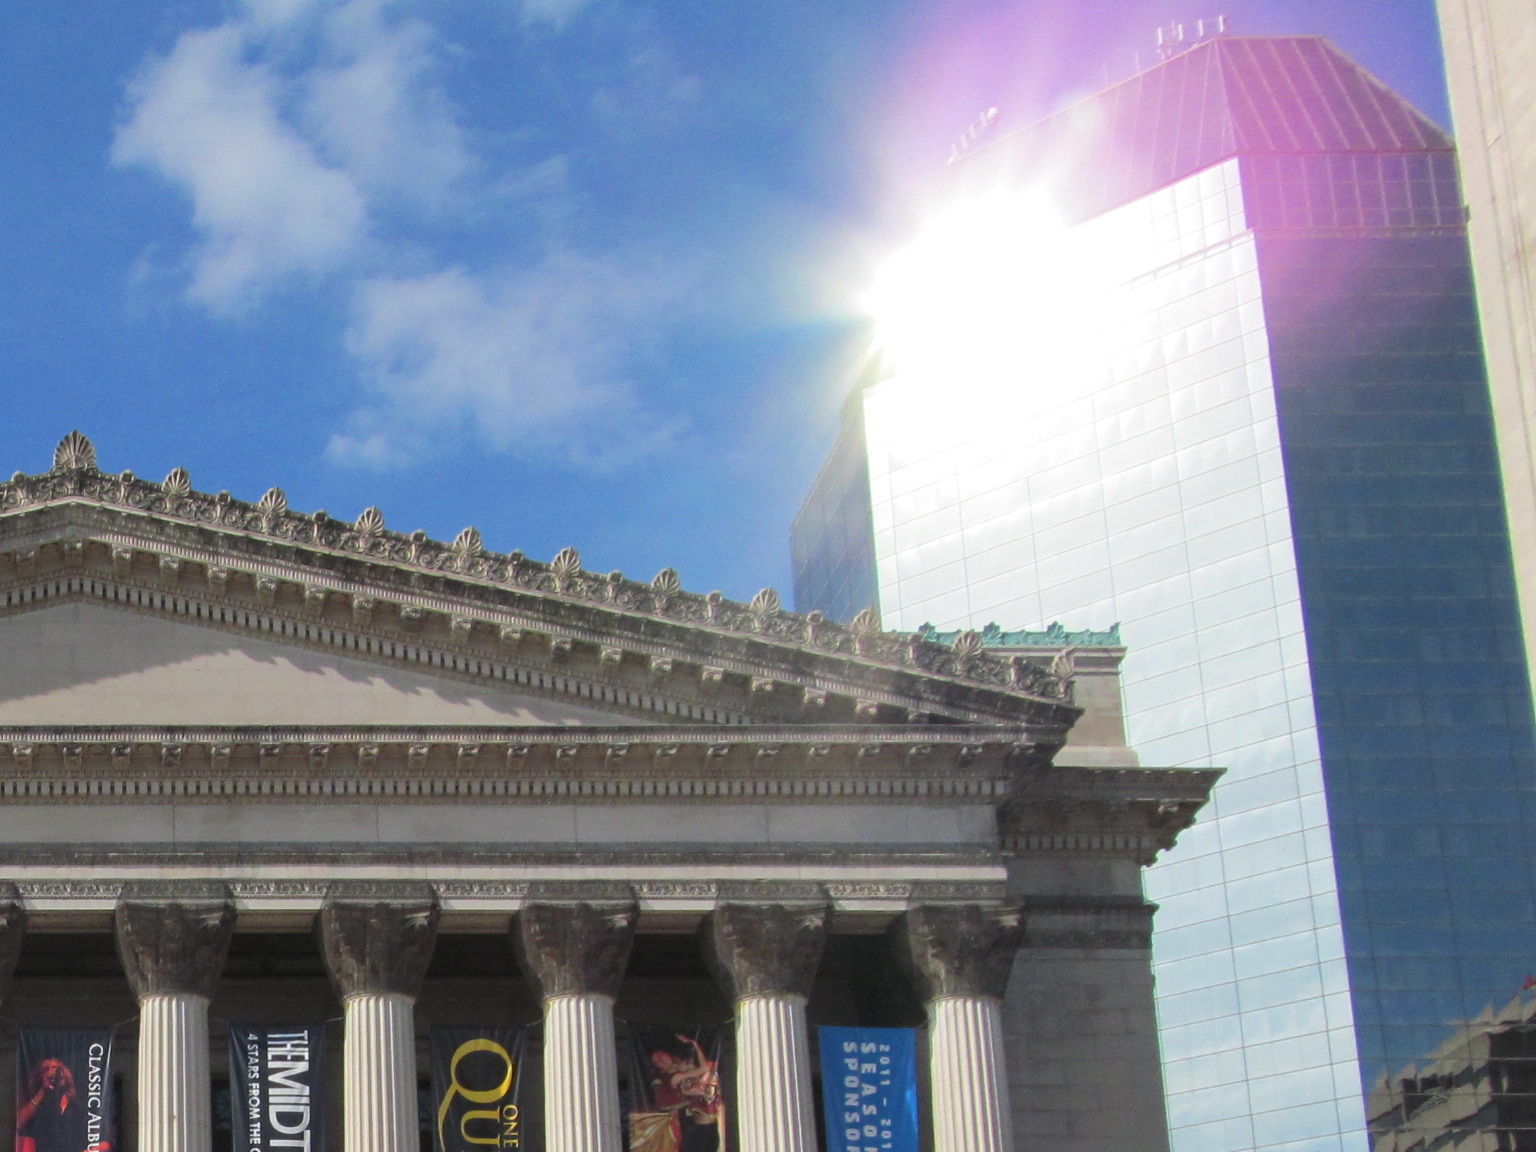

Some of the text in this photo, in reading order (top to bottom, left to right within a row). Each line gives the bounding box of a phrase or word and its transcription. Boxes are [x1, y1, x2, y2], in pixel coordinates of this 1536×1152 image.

[247, 1044, 260, 1078] STARS
[267, 1030, 309, 1060] THE
[87, 1043, 104, 1108] CLASSIC
[879, 1044, 891, 1086] 2011
[248, 1083, 261, 1119] FROM
[249, 1122, 261, 1144] THE
[503, 1104, 519, 1148] ONE
